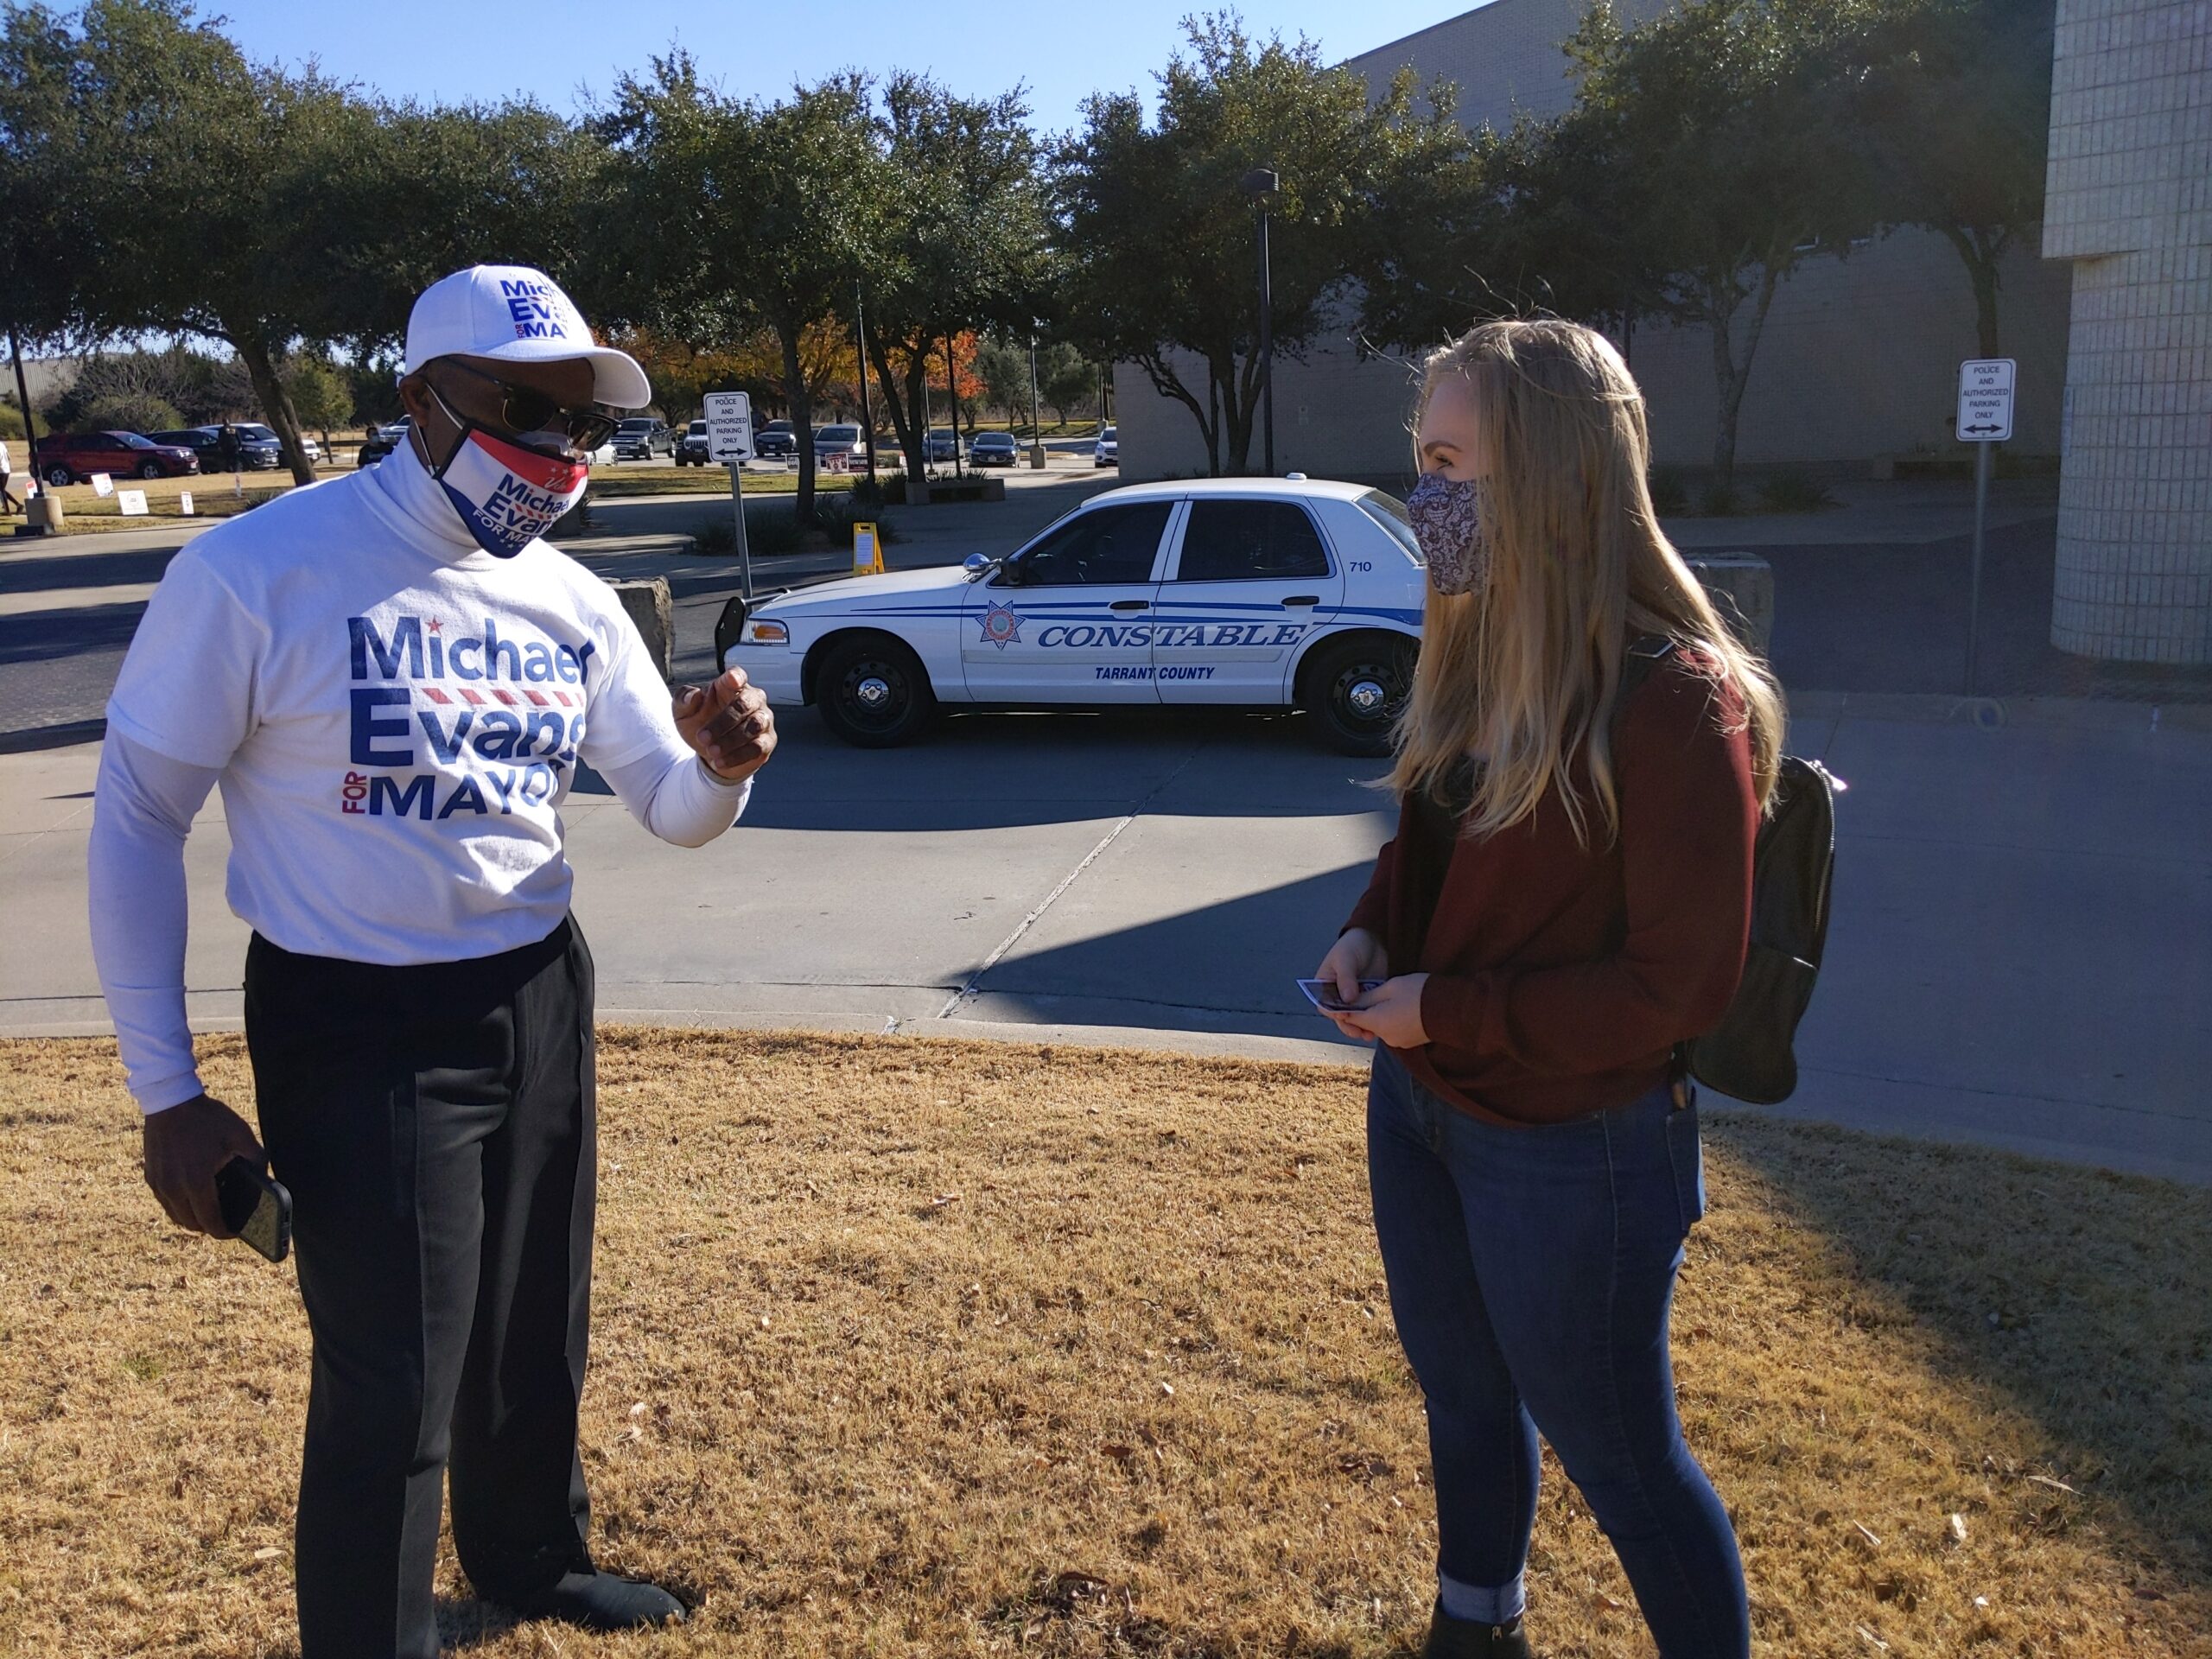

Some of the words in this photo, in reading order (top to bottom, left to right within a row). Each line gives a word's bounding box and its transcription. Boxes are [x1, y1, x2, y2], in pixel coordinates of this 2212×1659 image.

[515, 323, 525, 339] FOR
[473, 508, 505, 536] FOR
[505, 531, 534, 544] MA
[1350, 561, 1372, 572] 710
[1038, 623, 1309, 648] CONSTABLE
[1096, 667, 1156, 680] TARRANT
[1159, 667, 1215, 680] COUNTY
[342, 771, 367, 814] FOR
